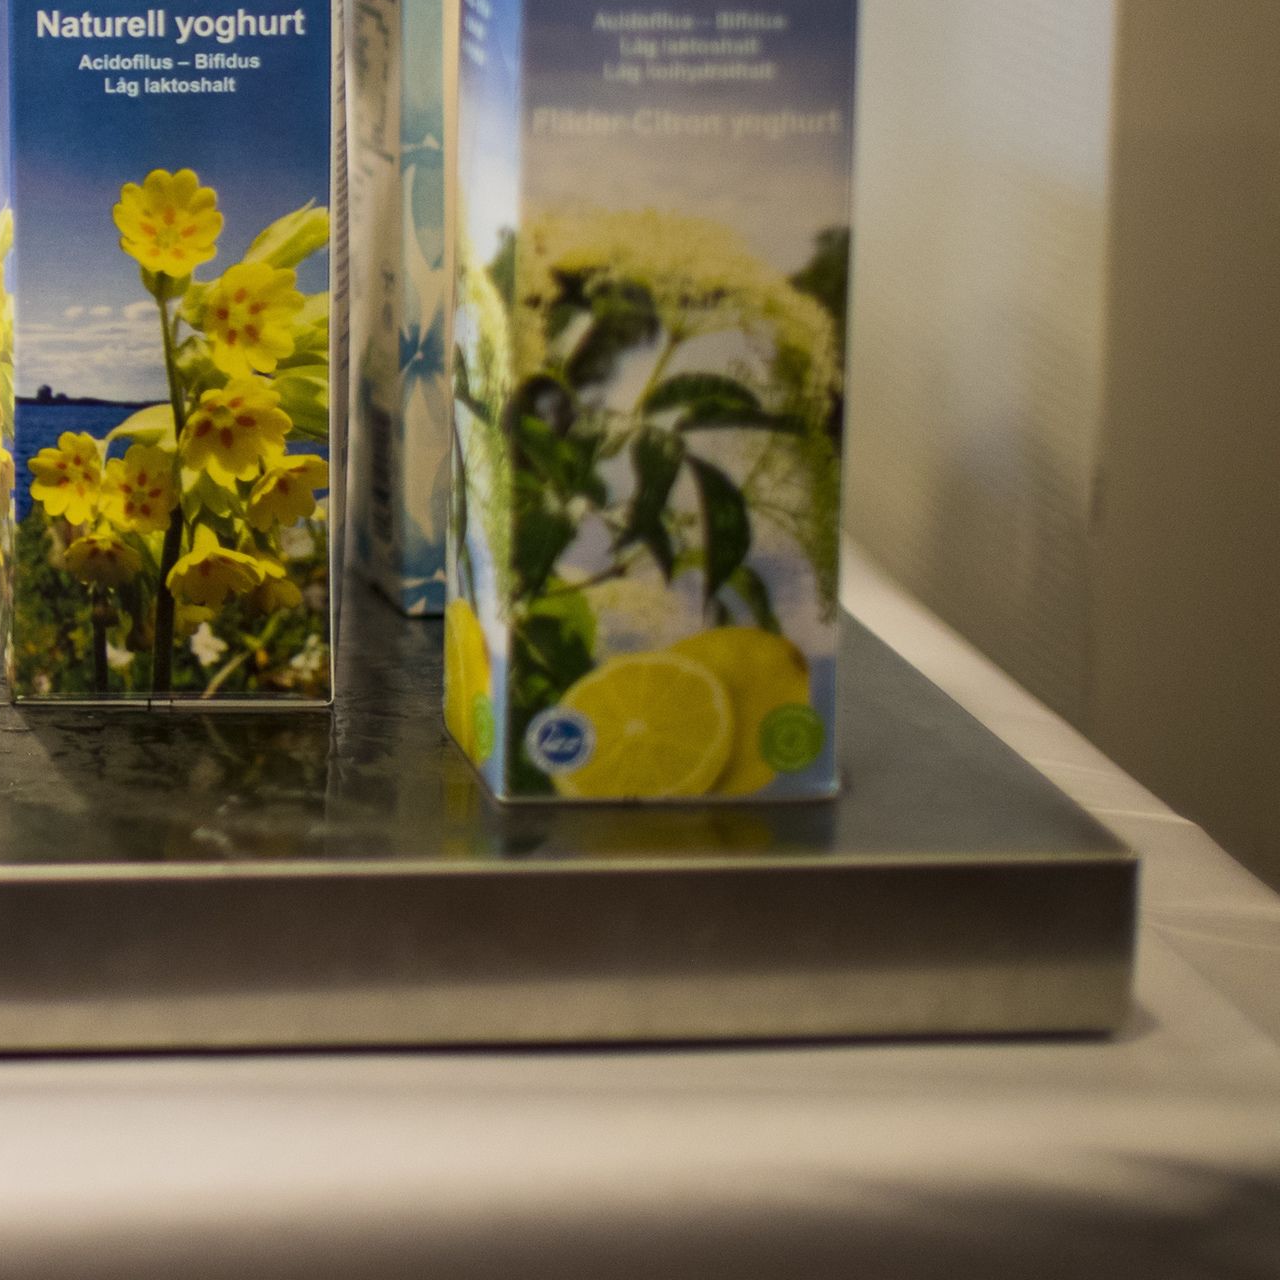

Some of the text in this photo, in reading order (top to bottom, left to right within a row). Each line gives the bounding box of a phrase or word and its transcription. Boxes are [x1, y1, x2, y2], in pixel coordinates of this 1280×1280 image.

[36, 8, 306, 44] Naturell yoghurt
[78, 54, 174, 71] Acidofilus
[194, 52, 261, 70] Bifidus
[104, 76, 237, 97] Låg laktoshalt
